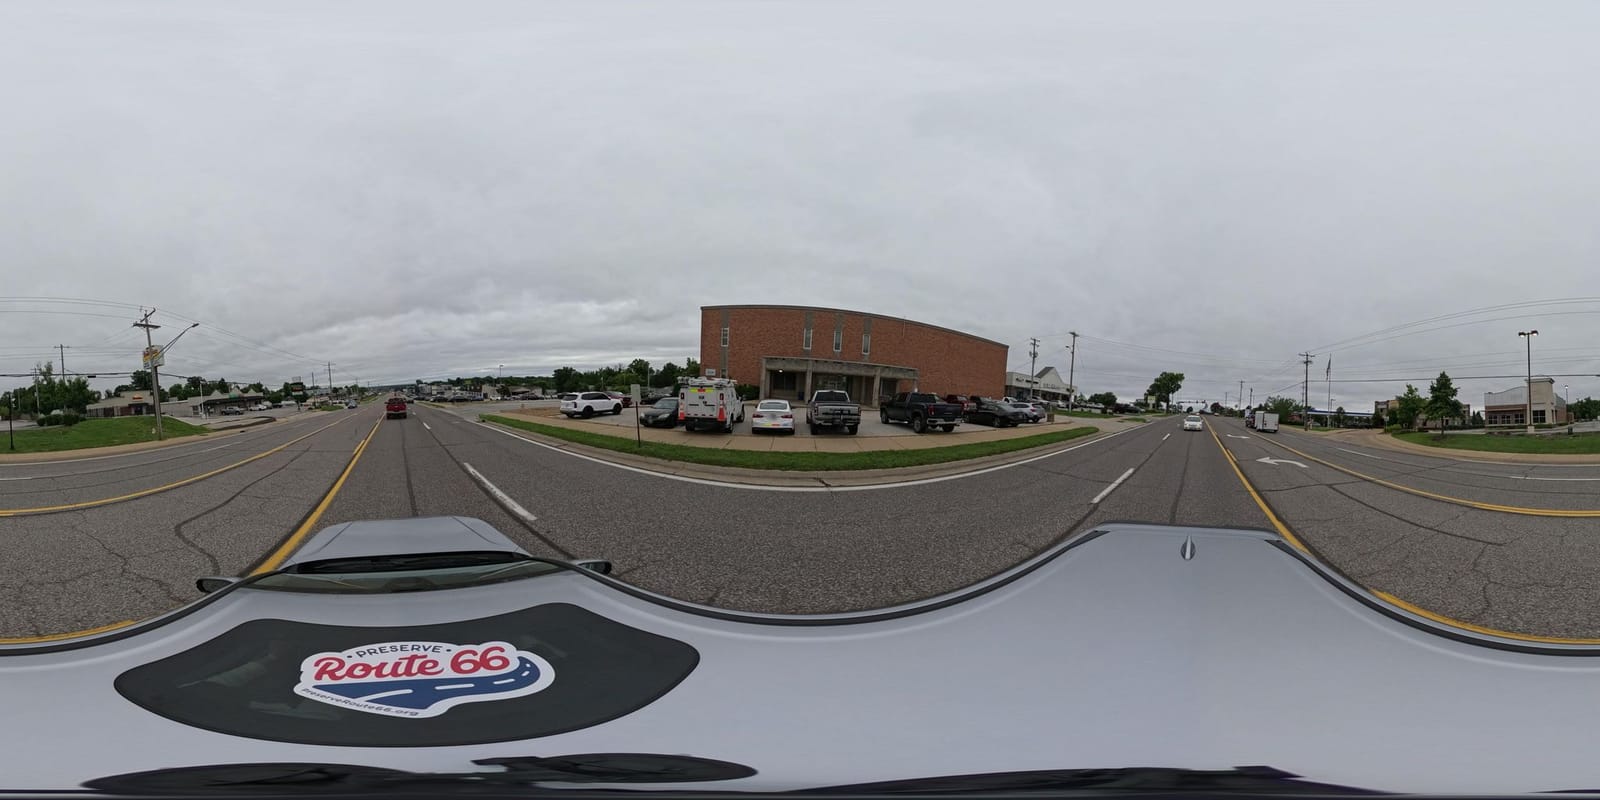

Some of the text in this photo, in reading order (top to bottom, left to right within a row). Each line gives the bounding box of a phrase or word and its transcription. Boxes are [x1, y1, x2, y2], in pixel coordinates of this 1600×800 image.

[314, 646, 510, 681] Route 66
[356, 644, 443, 658] PRESERVE
[301, 688, 419, 717] PreserveRoute66.org
